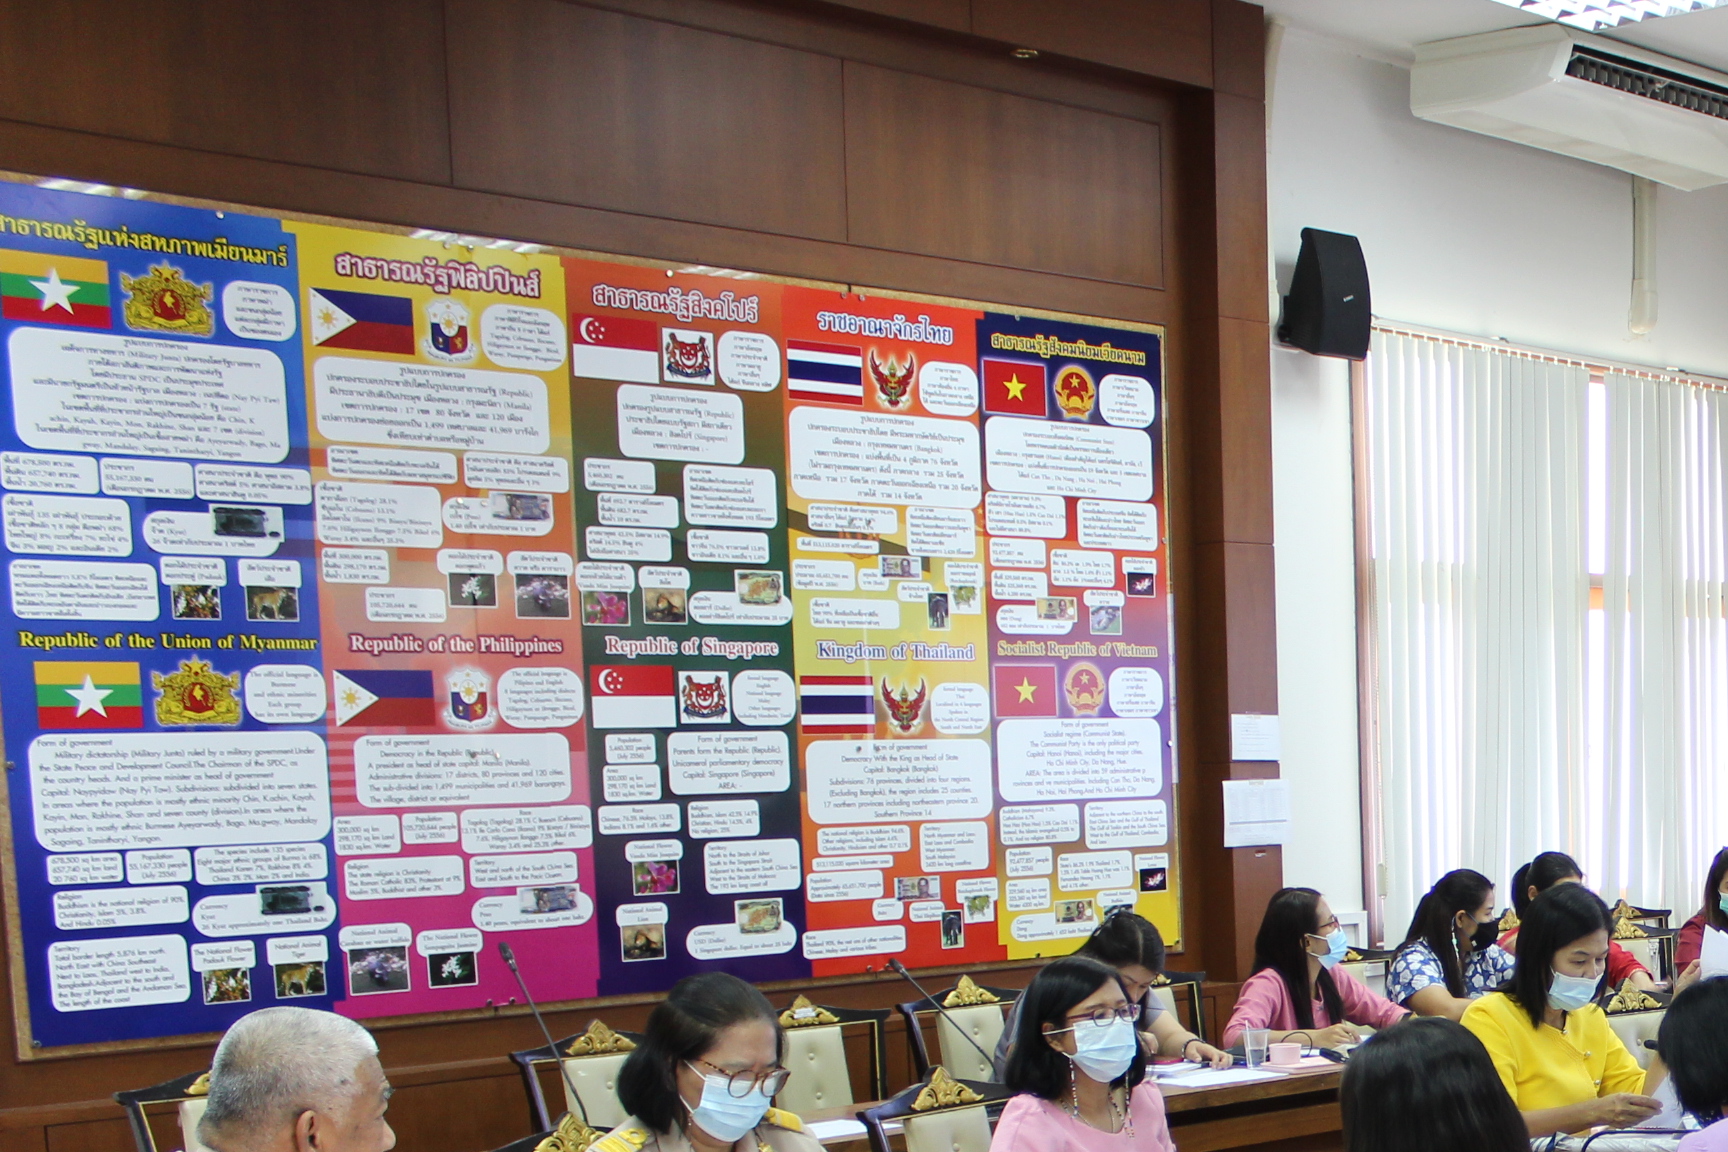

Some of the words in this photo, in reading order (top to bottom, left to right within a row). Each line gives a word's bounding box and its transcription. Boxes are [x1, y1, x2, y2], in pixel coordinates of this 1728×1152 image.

[334, 252, 541, 298] สาธารณรัฐฟิลิปปินส์
[592, 283, 760, 324] สาธารณรัฐสิงคโปร์
[816, 311, 953, 345] ราชอาณาจักรไทย
[18, 630, 99, 651] Republic
[104, 632, 123, 648] of
[128, 632, 155, 649] the
[160, 633, 212, 649] Union
[217, 634, 235, 650] of
[239, 634, 319, 653] Myanmar
[349, 634, 423, 657] Republic
[427, 635, 446, 653] of
[449, 635, 475, 654] the
[478, 636, 564, 657] Philippines
[605, 635, 678, 658] Republic
[681, 636, 699, 655] of
[702, 637, 779, 659] Singapore
[816, 640, 887, 662] Kingdom
[890, 641, 909, 660] of
[911, 642, 976, 661] Thailand
[997, 640, 1045, 657] Socialist
[1047, 642, 1097, 659] Republic
[1099, 643, 1112, 657] of
[1113, 643, 1158, 658] Vietnam
[37, 738, 56, 747] Form
[59, 738, 67, 747] of
[69, 739, 113, 748] government
[366, 739, 382, 747] Form
[384, 738, 391, 747] of
[393, 739, 430, 748] government
[697, 735, 713, 743] Form
[715, 735, 722, 743] of
[723, 735, 758, 744] government
[697, 747, 712, 755] form
[724, 747, 750, 756] Republic
[873, 743, 887, 751] Frm
[896, 744, 928, 752] government
[54, 751, 83, 760] Military
[86, 749, 129, 760] dictatorship
[187, 748, 205, 756] ruled
[207, 747, 217, 758] by
[226, 747, 251, 758] military
[380, 750, 415, 759] Democracy
[425, 749, 435, 757] the
[437, 749, 463, 758] Republic
[841, 755, 872, 763] Democracy
[899, 755, 913, 763] King
[921, 754, 937, 762] Head
[376, 761, 405, 770] president
[415, 760, 432, 768] head
[672, 759, 707, 767] Unicameral
[709, 759, 750, 768] parliamentary
[752, 758, 784, 768] democracy
[708, 770, 739, 780] Singapore
[740, 769, 776, 779] (Singapore)
[886, 766, 910, 774] Bangkok
